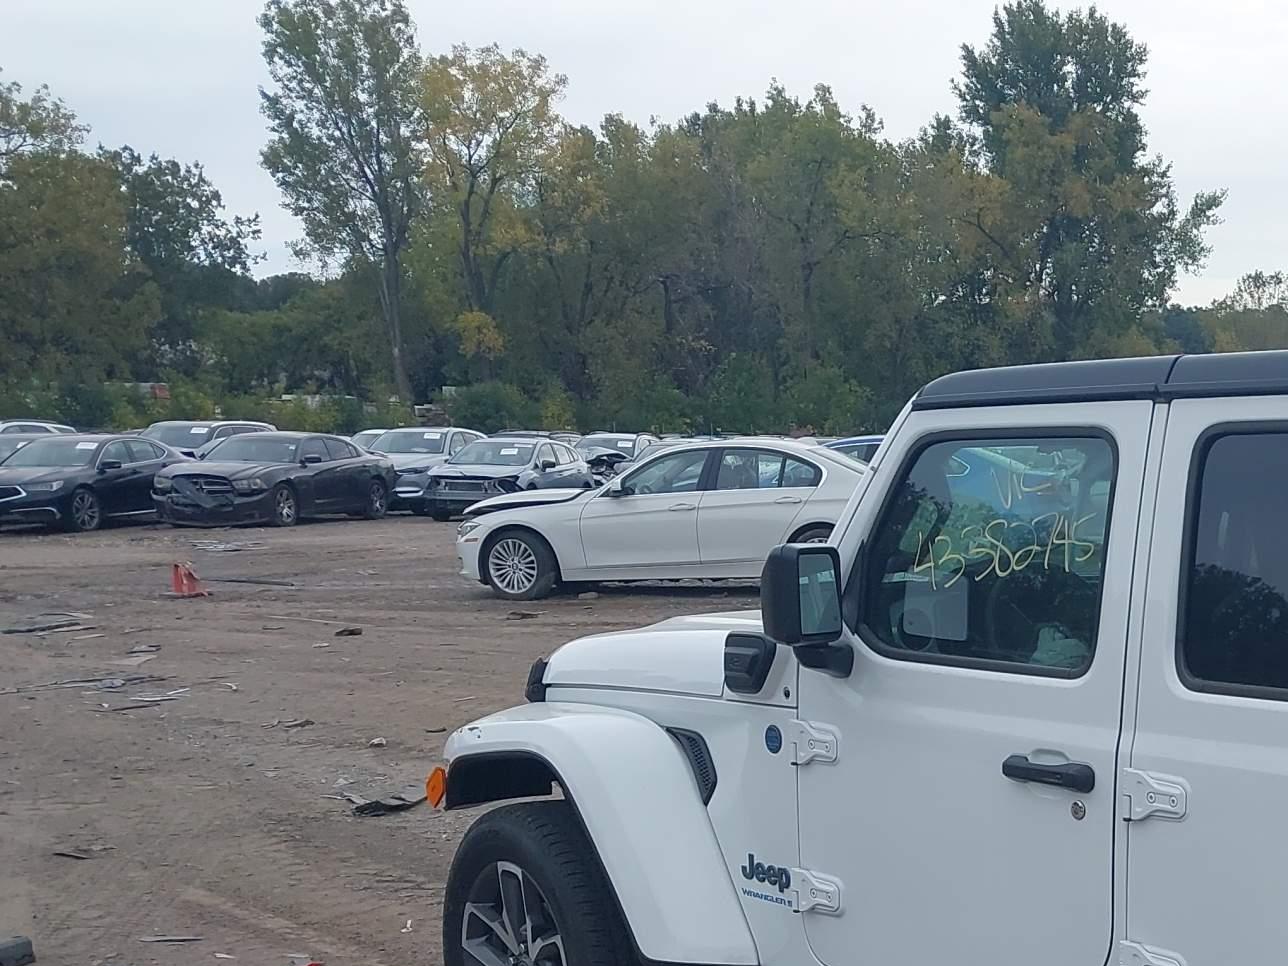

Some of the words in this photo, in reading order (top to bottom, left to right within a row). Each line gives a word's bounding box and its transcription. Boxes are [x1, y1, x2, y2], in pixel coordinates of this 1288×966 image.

[913, 512, 1097, 590] 43382745
[741, 852, 792, 894] Jeep
[741, 887, 787, 906] WRANGLER
